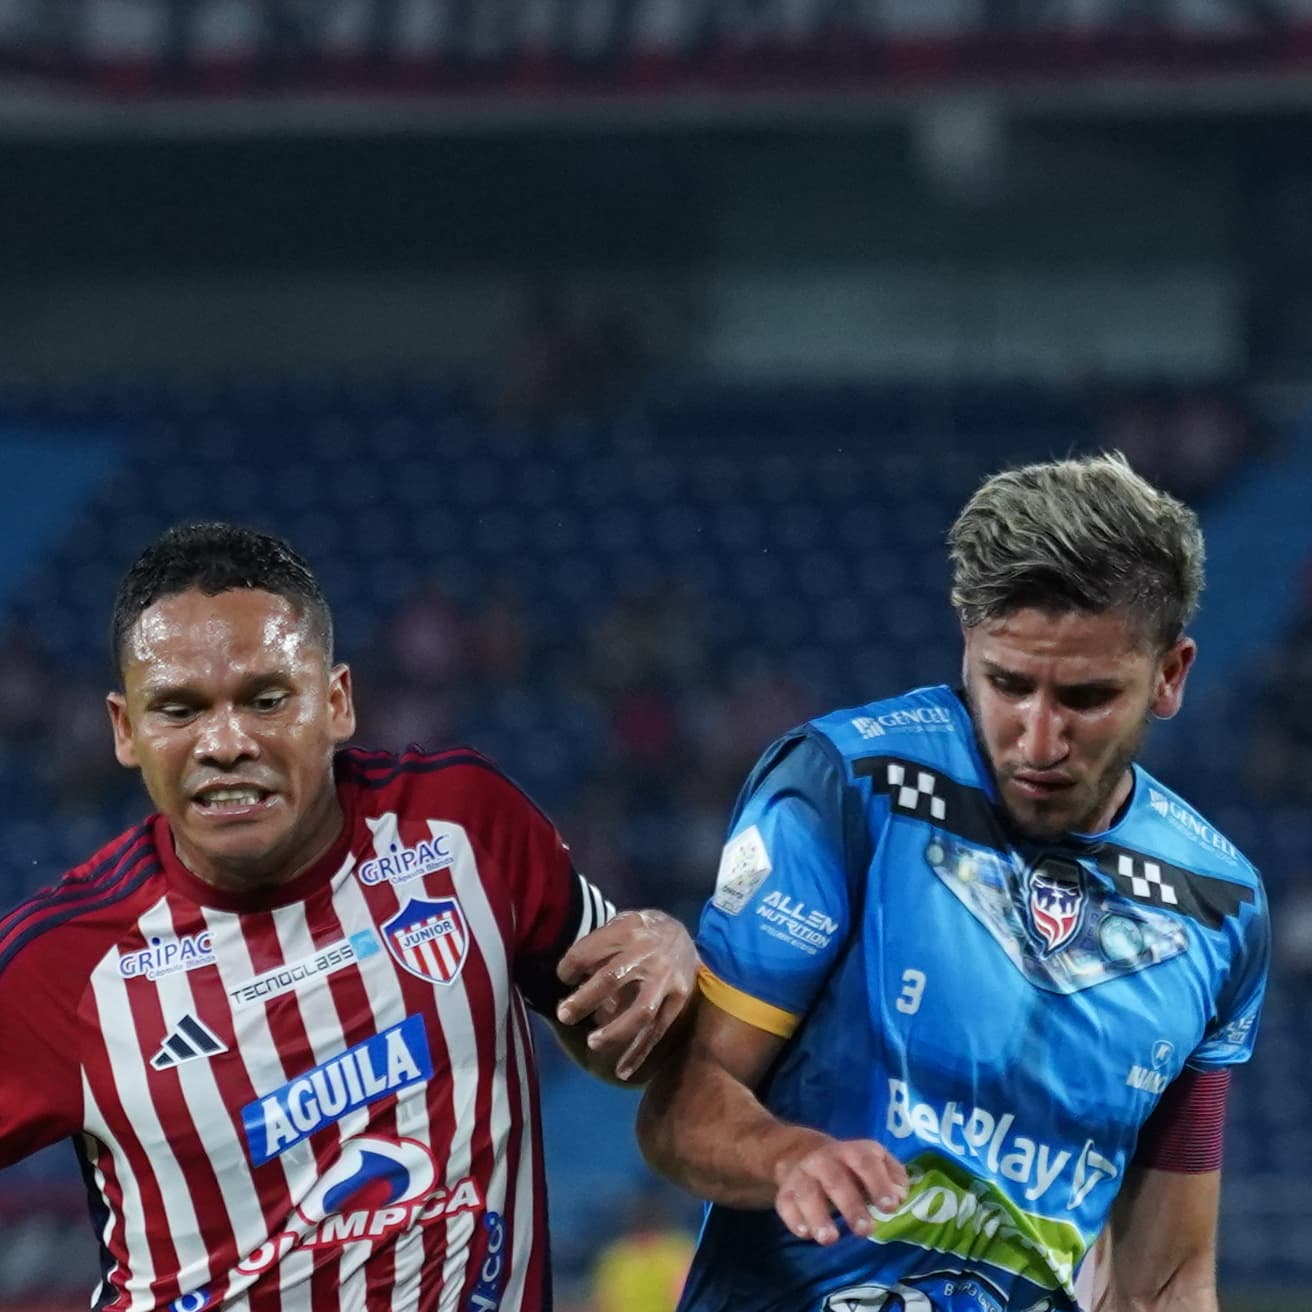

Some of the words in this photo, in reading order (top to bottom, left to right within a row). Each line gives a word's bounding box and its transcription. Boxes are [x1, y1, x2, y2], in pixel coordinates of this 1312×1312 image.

[404, 920, 453, 947] JUNIOR
[755, 905, 832, 948] NUTRITION
[762, 890, 839, 935] ALLEN
[895, 968, 926, 1015] 3
[265, 1030, 422, 1157] AGUILA
